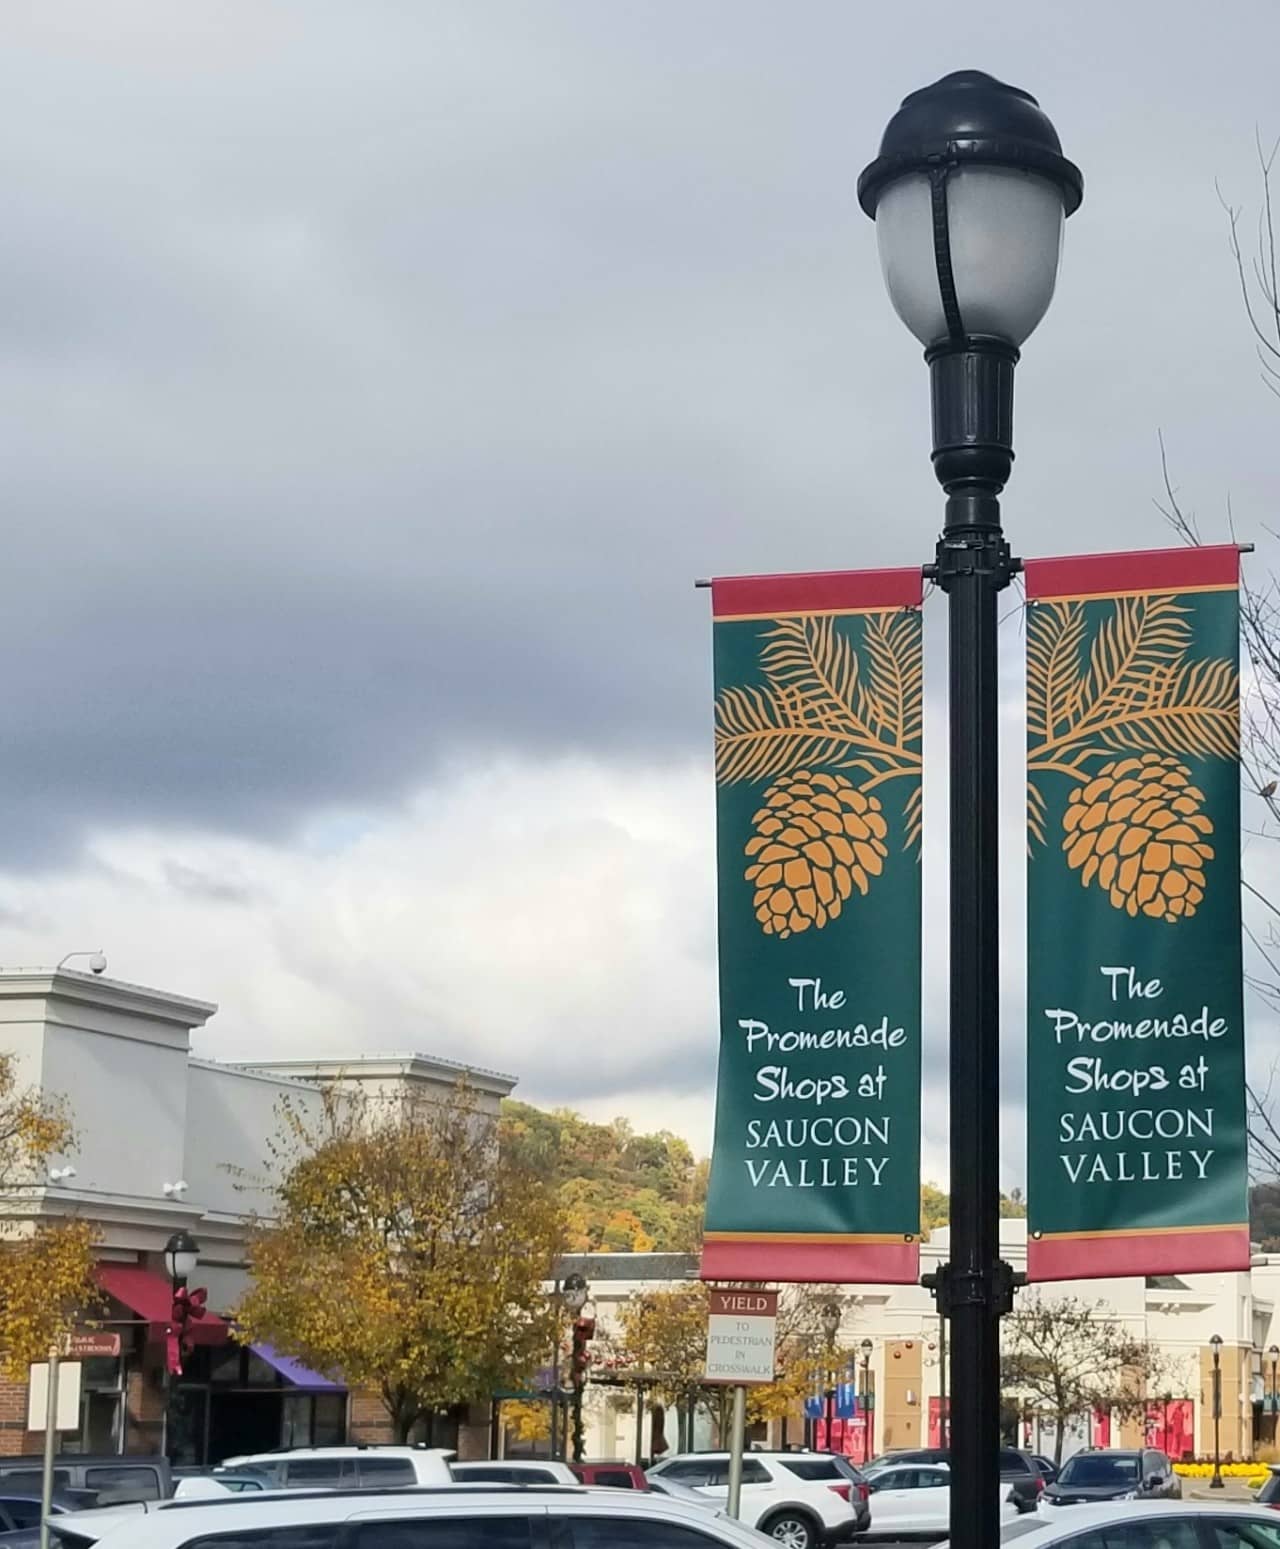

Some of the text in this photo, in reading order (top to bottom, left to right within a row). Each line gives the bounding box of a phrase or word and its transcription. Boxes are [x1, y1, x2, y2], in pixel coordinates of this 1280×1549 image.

[788, 978, 846, 1011] The
[1100, 966, 1163, 1001] The
[738, 1016, 907, 1053] Promenade
[1044, 1006, 1228, 1044] Promenade
[753, 1065, 887, 1105] Shops at
[1065, 1055, 1209, 1097] Shops at
[746, 1117, 890, 1148] SAUCON
[1059, 1108, 1214, 1143] SAUCON
[744, 1157, 890, 1188] VALLEY
[1060, 1150, 1214, 1183] VALLEY
[720, 1296, 768, 1311] YIELD
[736, 1322, 750, 1332] TO
[708, 1363, 771, 1375] CROSSWALK
